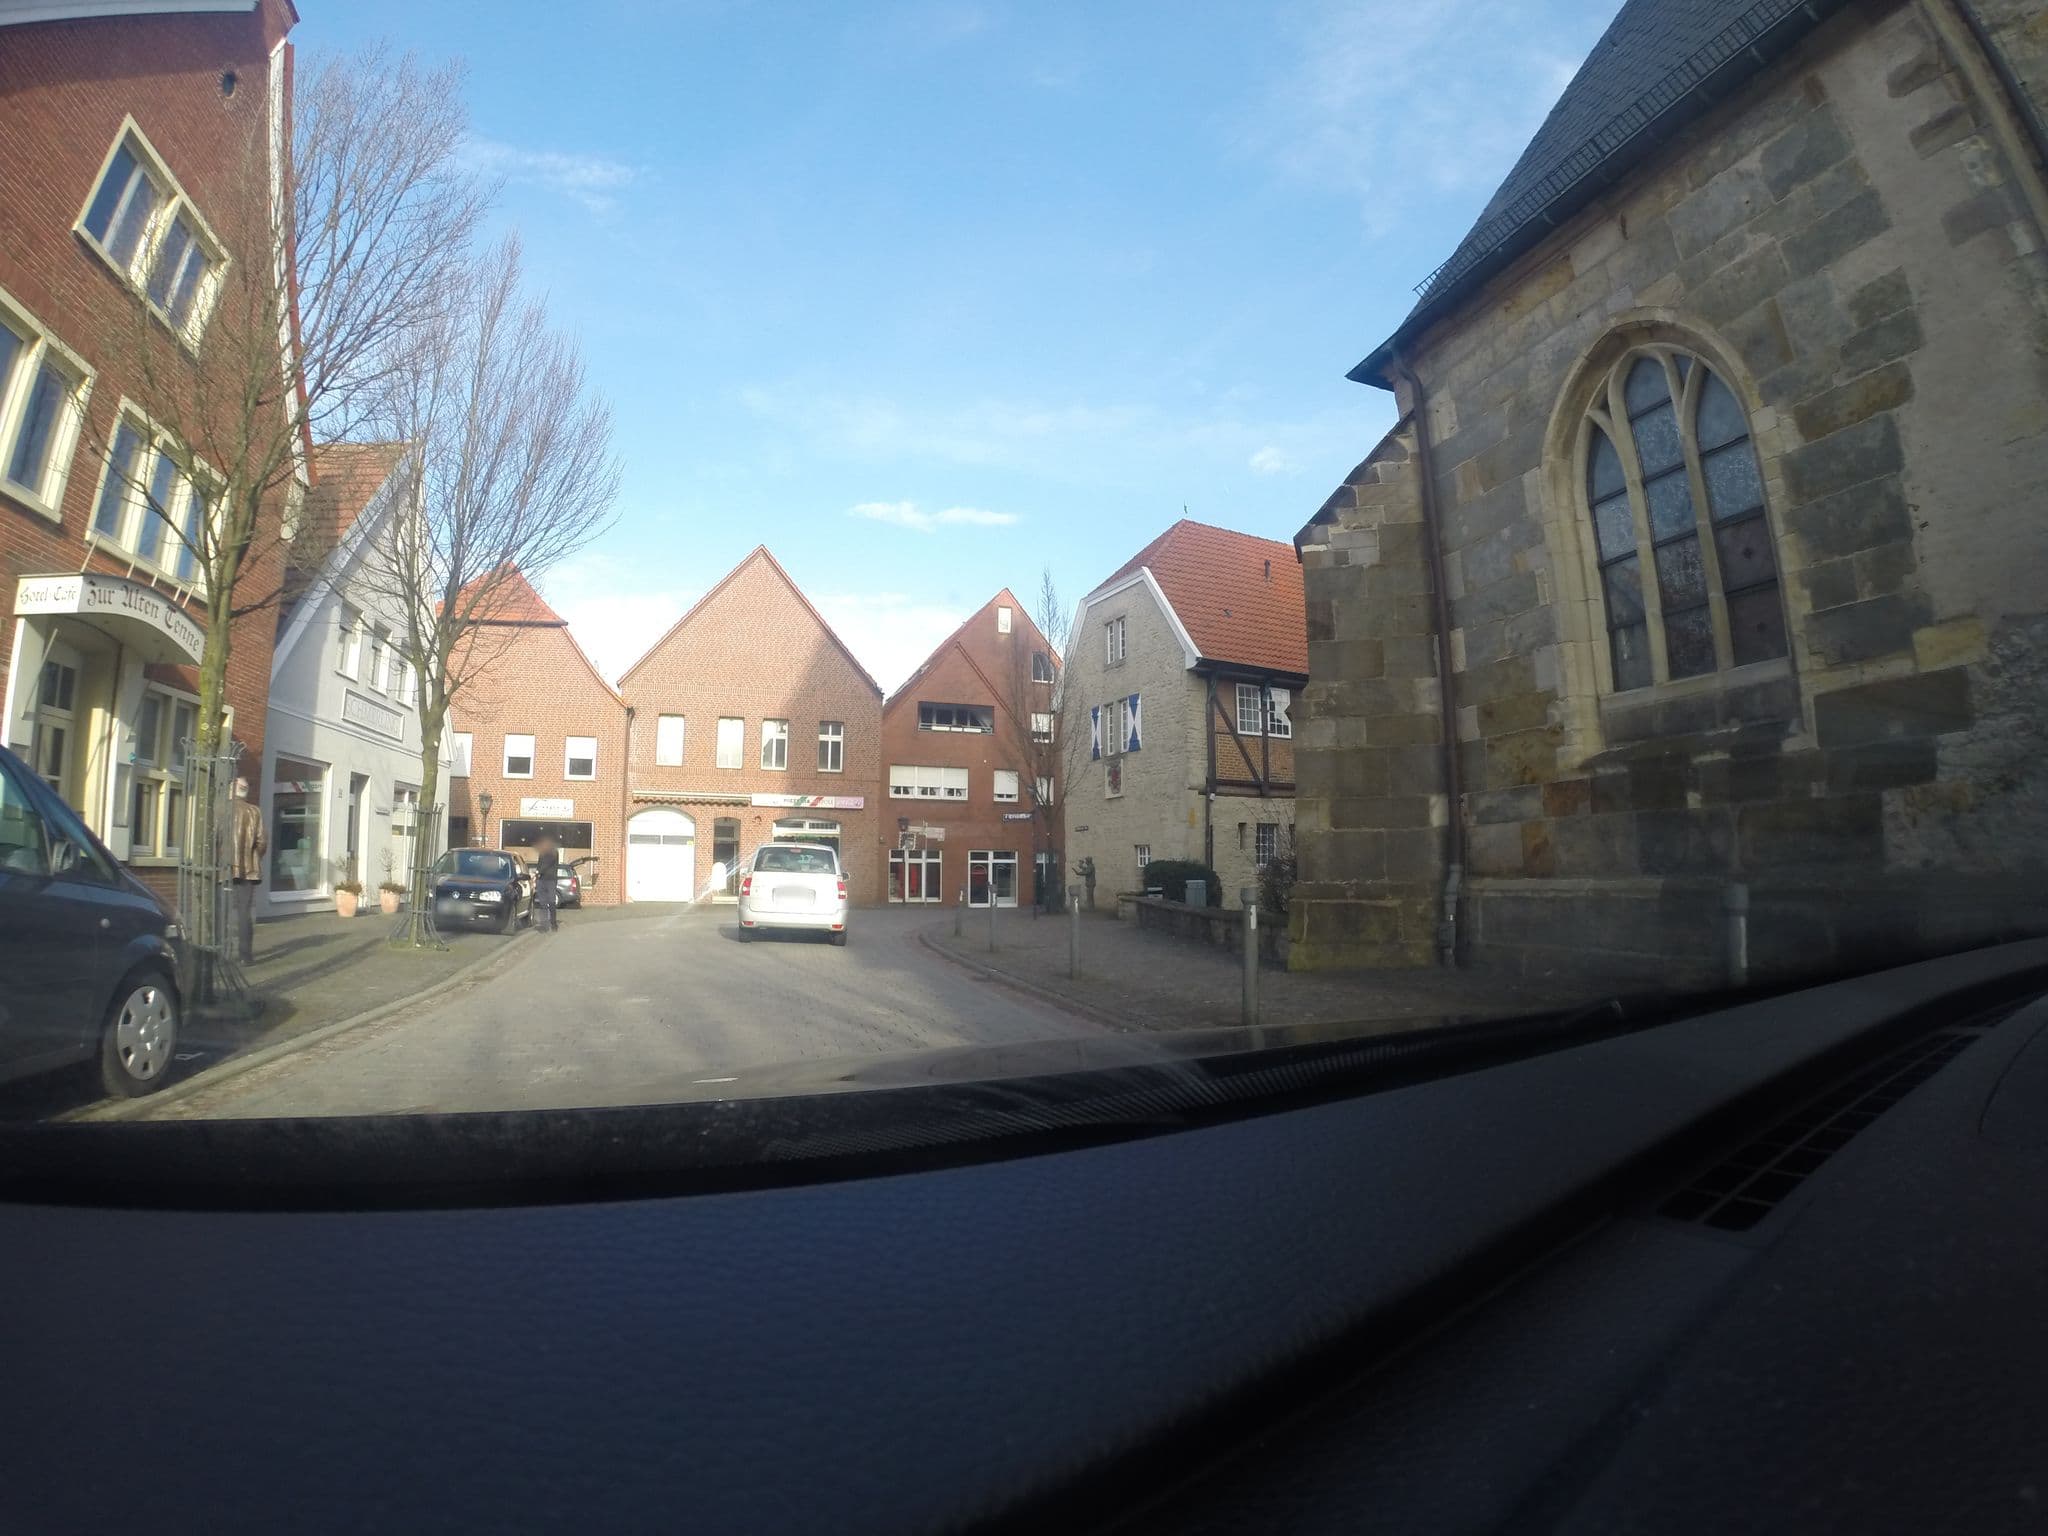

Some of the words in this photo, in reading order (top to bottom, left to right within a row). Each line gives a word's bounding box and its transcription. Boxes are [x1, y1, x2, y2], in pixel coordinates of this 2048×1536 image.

[87, 580, 115, 607] Zur
[121, 584, 160, 619] Alten
[164, 604, 200, 652] Tenne
